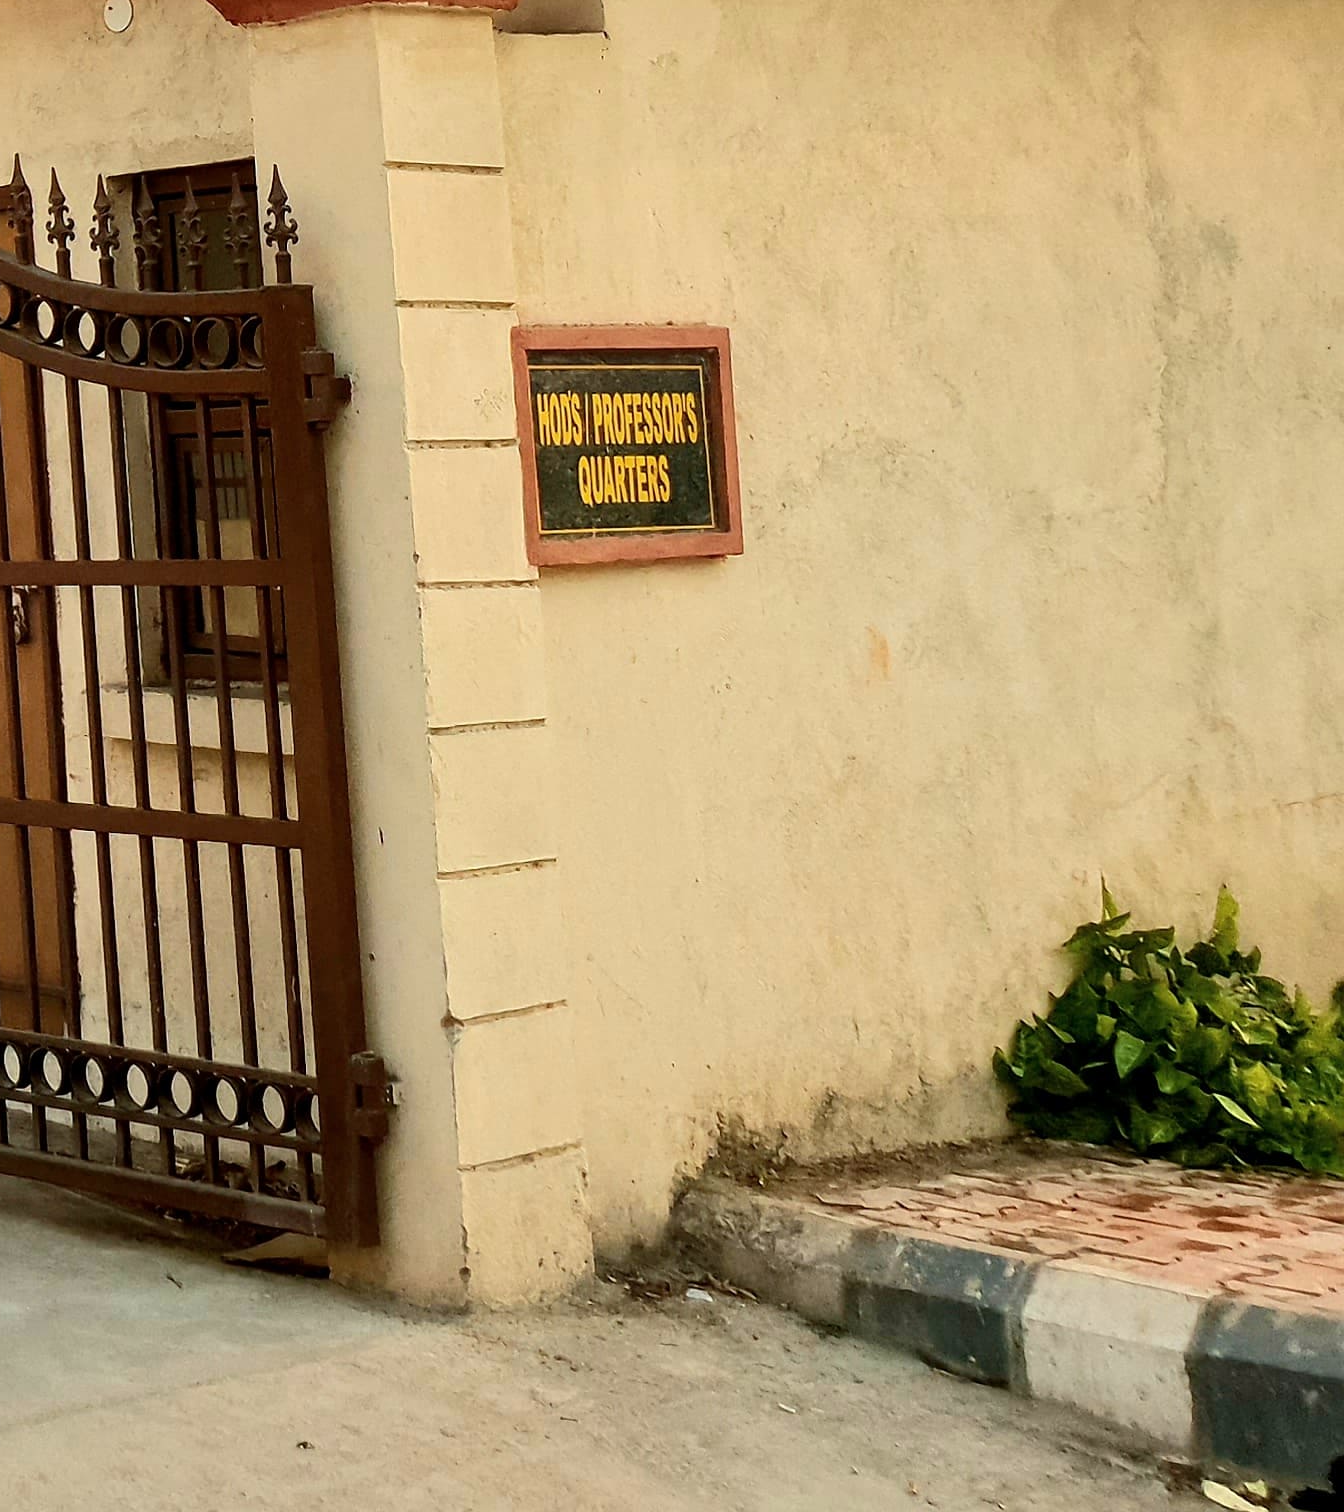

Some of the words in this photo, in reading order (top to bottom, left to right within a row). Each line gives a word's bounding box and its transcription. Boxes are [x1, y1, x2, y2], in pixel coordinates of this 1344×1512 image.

[536, 390, 583, 447] HOD'S
[592, 391, 699, 446] PROFESSOR'S
[577, 454, 672, 508] QUARTERS
